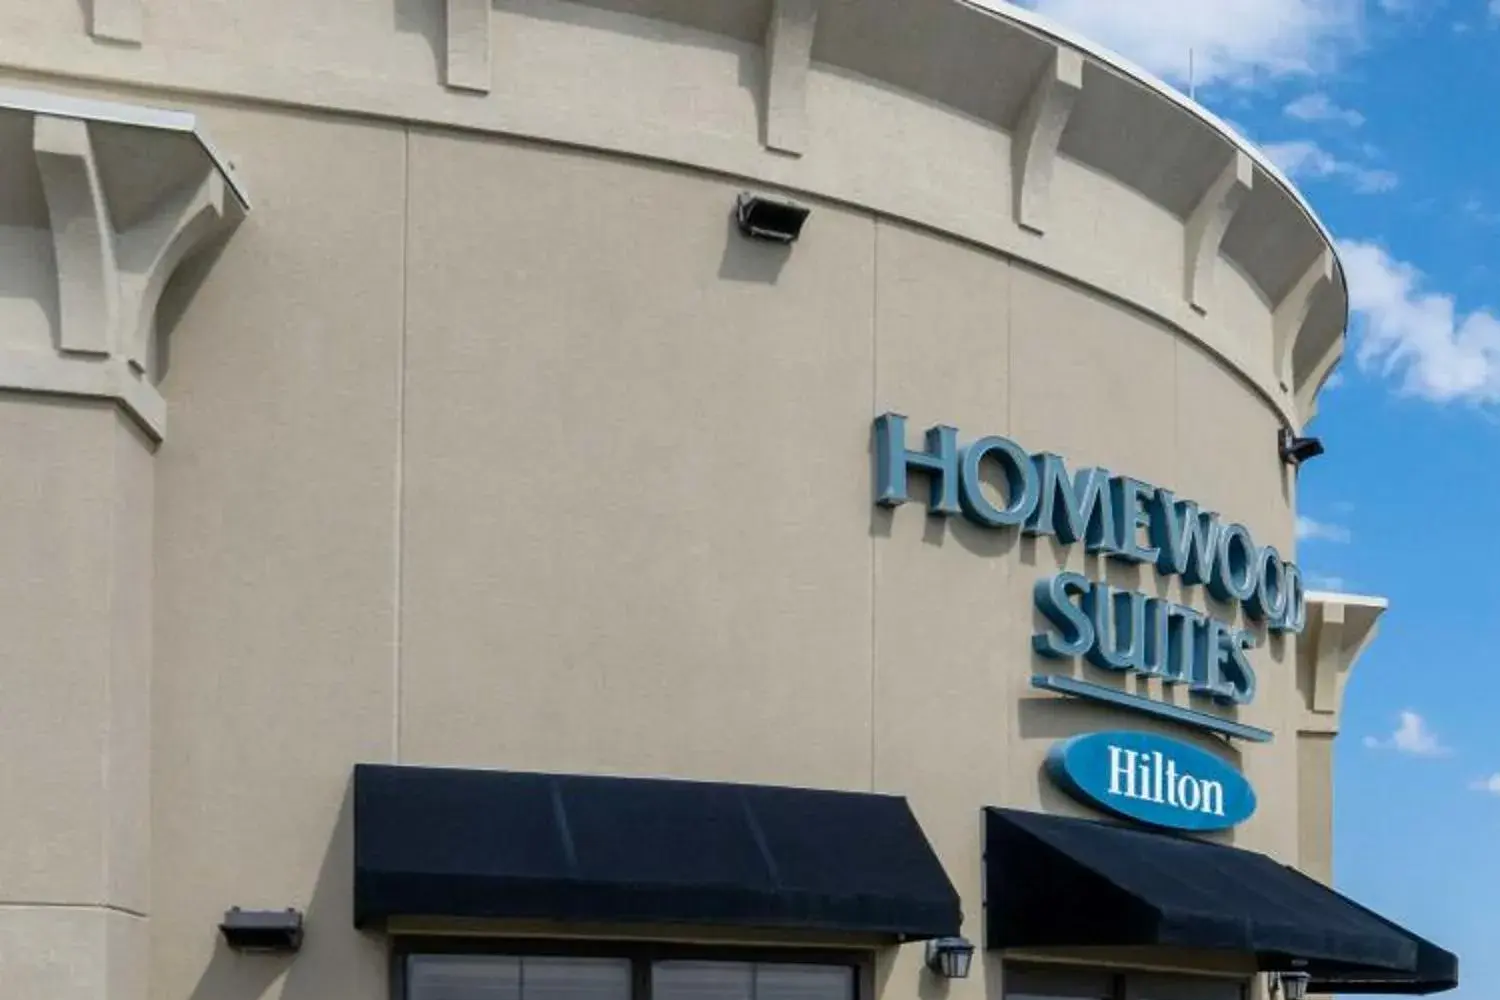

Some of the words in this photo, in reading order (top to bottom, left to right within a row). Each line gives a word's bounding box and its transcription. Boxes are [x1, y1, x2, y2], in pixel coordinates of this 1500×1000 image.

[875, 412, 1306, 634] HOMEWOOD
[1031, 571, 1258, 705] SUITES
[1107, 744, 1225, 817] Hilton
